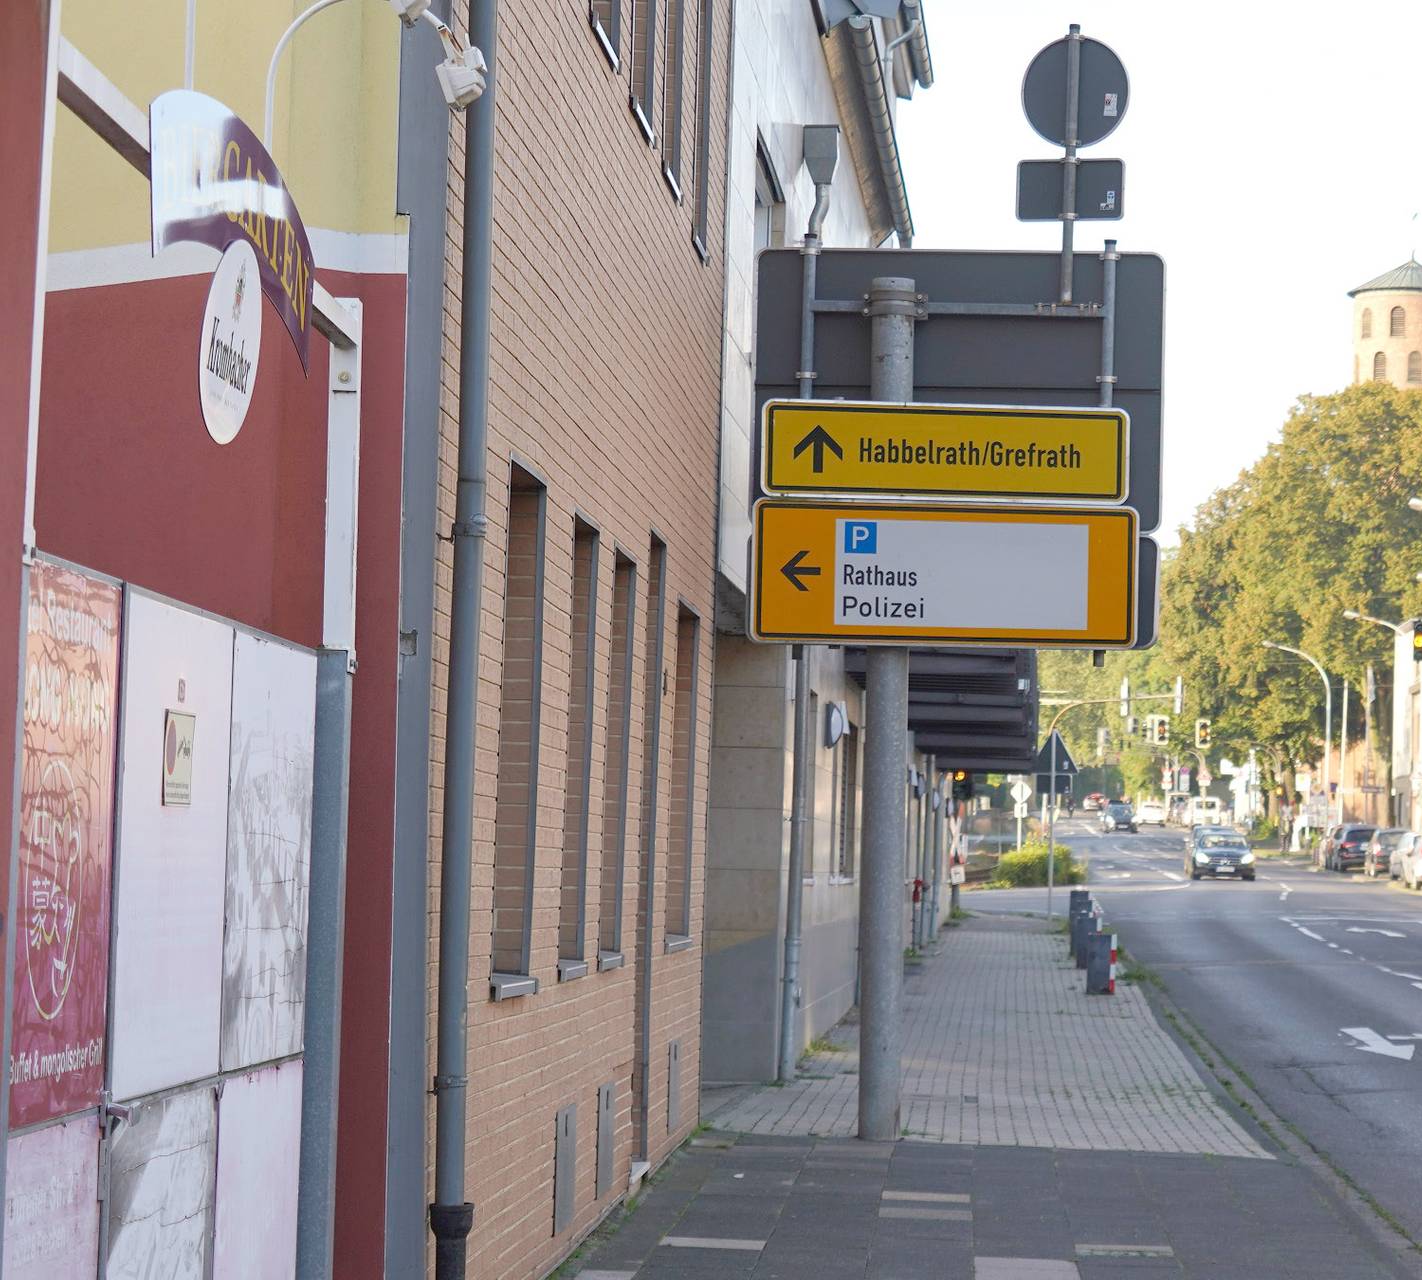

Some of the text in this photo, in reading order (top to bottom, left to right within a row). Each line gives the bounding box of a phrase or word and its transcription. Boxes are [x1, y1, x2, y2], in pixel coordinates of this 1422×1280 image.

[207, 316, 252, 395] Krombacher
[859, 437, 1081, 469] Habbelrath/Grefrath
[851, 526, 870, 550] P
[843, 563, 918, 587] Rathaus
[842, 596, 925, 619] Polizei
[10, 1036, 103, 1085] Buffet & mongolischer Grill
